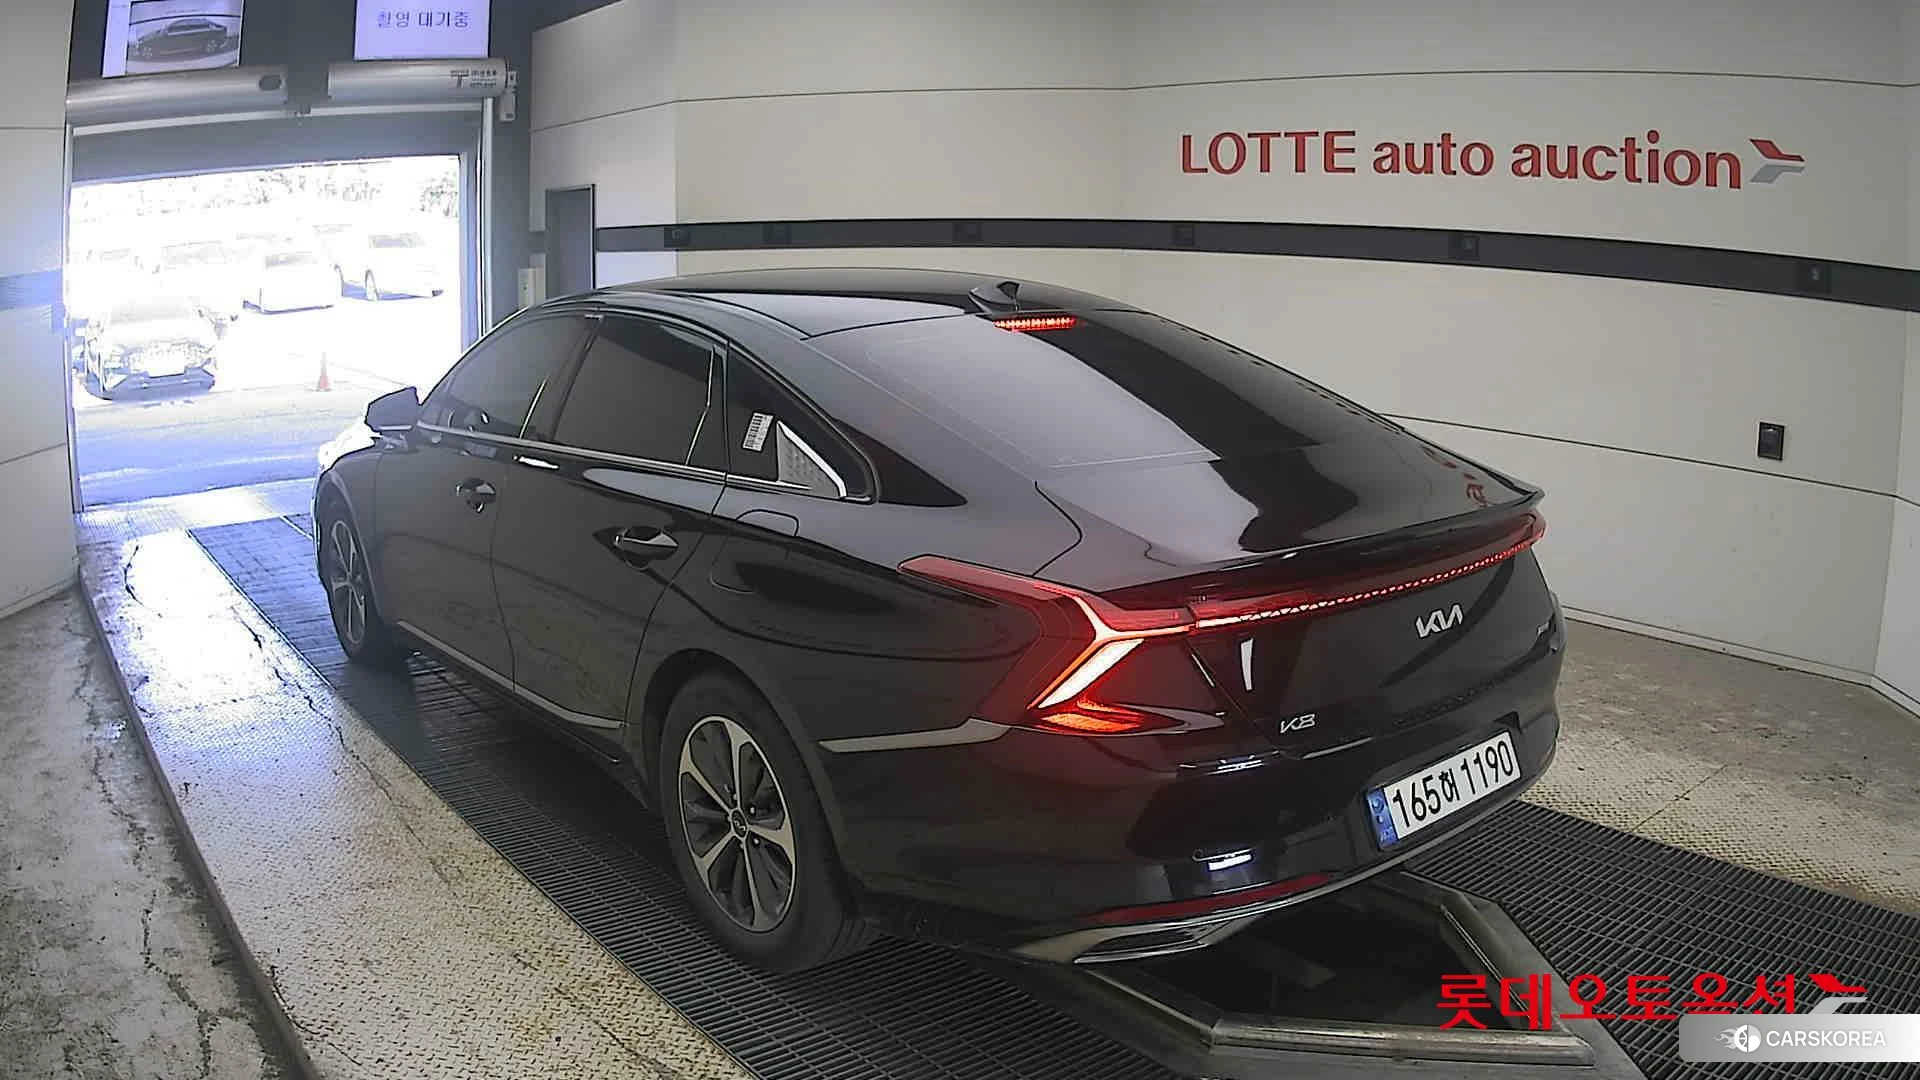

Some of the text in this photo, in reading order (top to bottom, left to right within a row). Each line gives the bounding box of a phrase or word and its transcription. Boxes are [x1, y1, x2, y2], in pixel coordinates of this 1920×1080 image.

[1182, 130, 1742, 188] LOTTE auto auction
[1415, 603, 1463, 638] KIA
[1280, 713, 1316, 734] K8
[1392, 740, 1514, 829] 165허 1190
